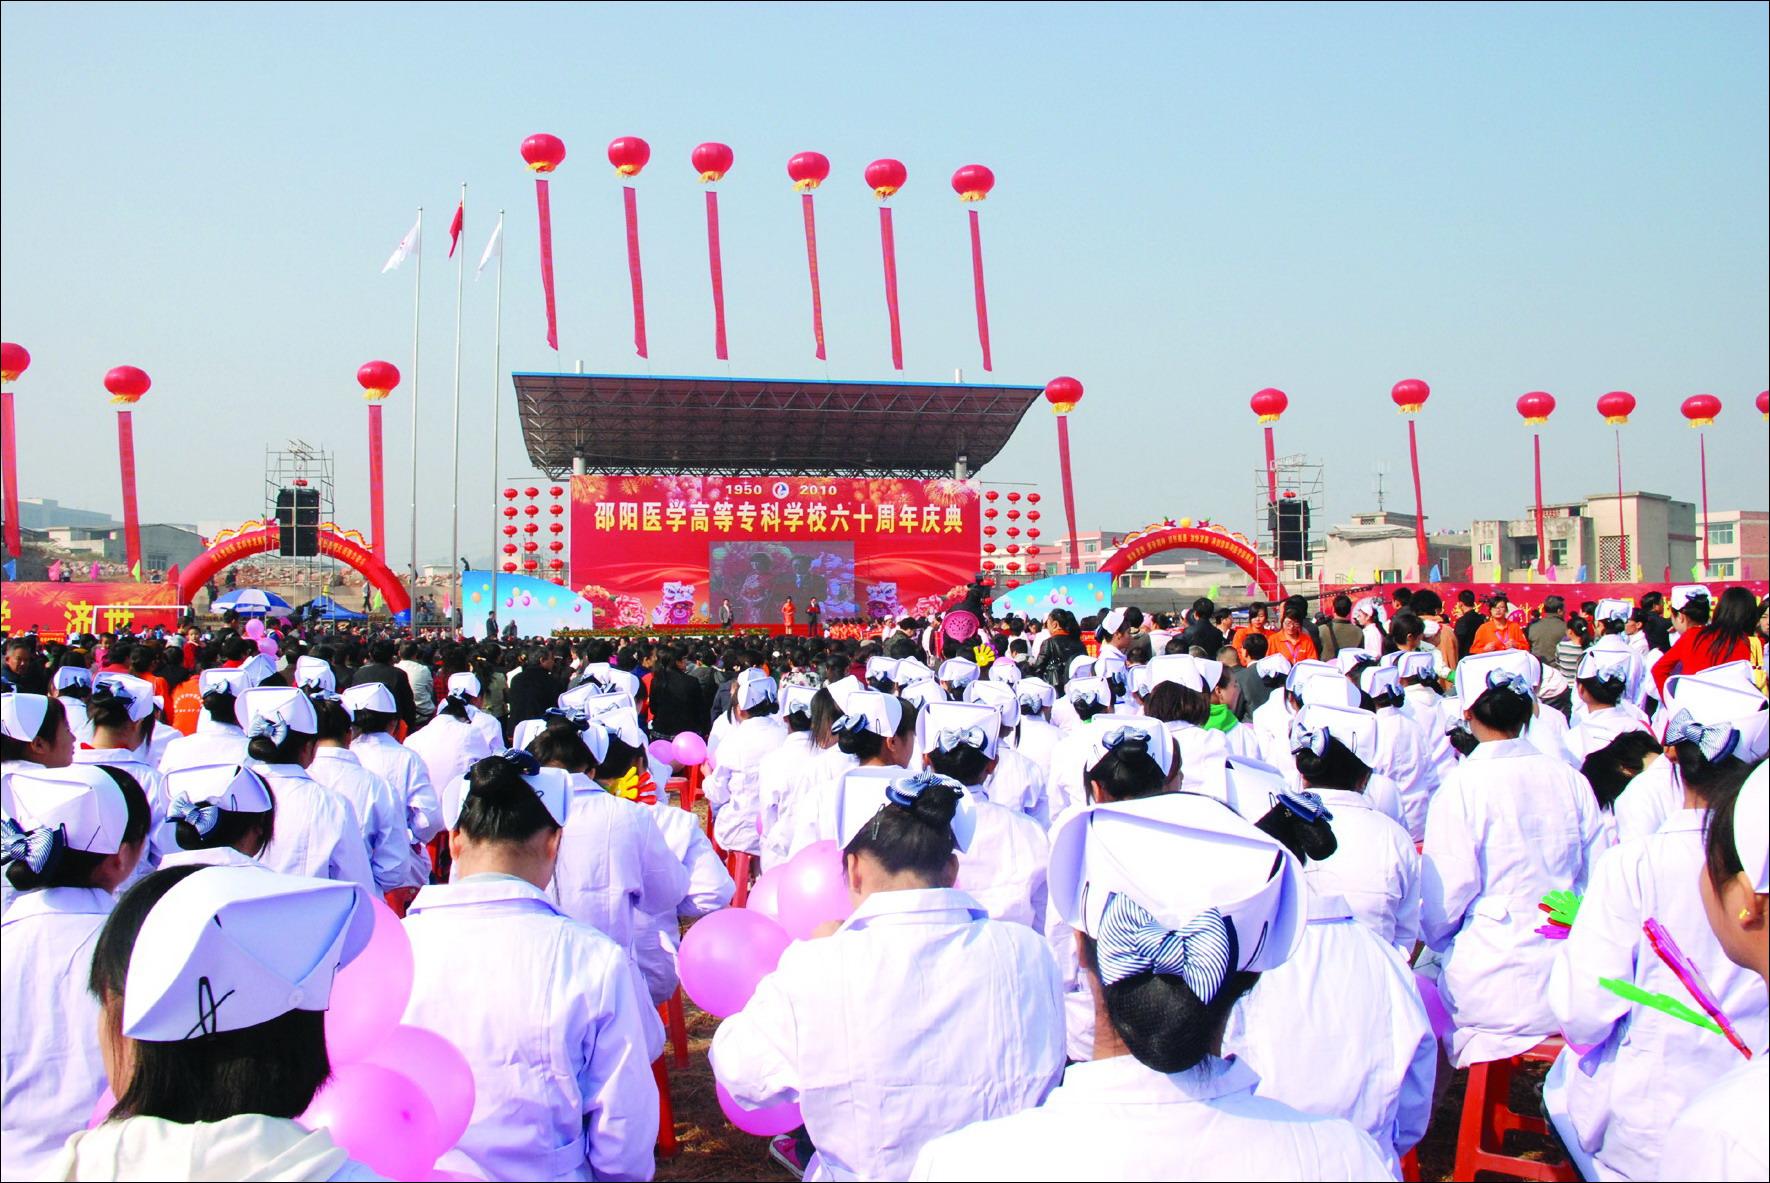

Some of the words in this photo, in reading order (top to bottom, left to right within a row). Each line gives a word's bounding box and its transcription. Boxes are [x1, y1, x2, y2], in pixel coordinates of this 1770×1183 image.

[725, 485, 762, 495] 1950
[799, 485, 837, 495] 2010
[594, 501, 963, 534] 邵阳医学高等专科学校六十周年庆典
